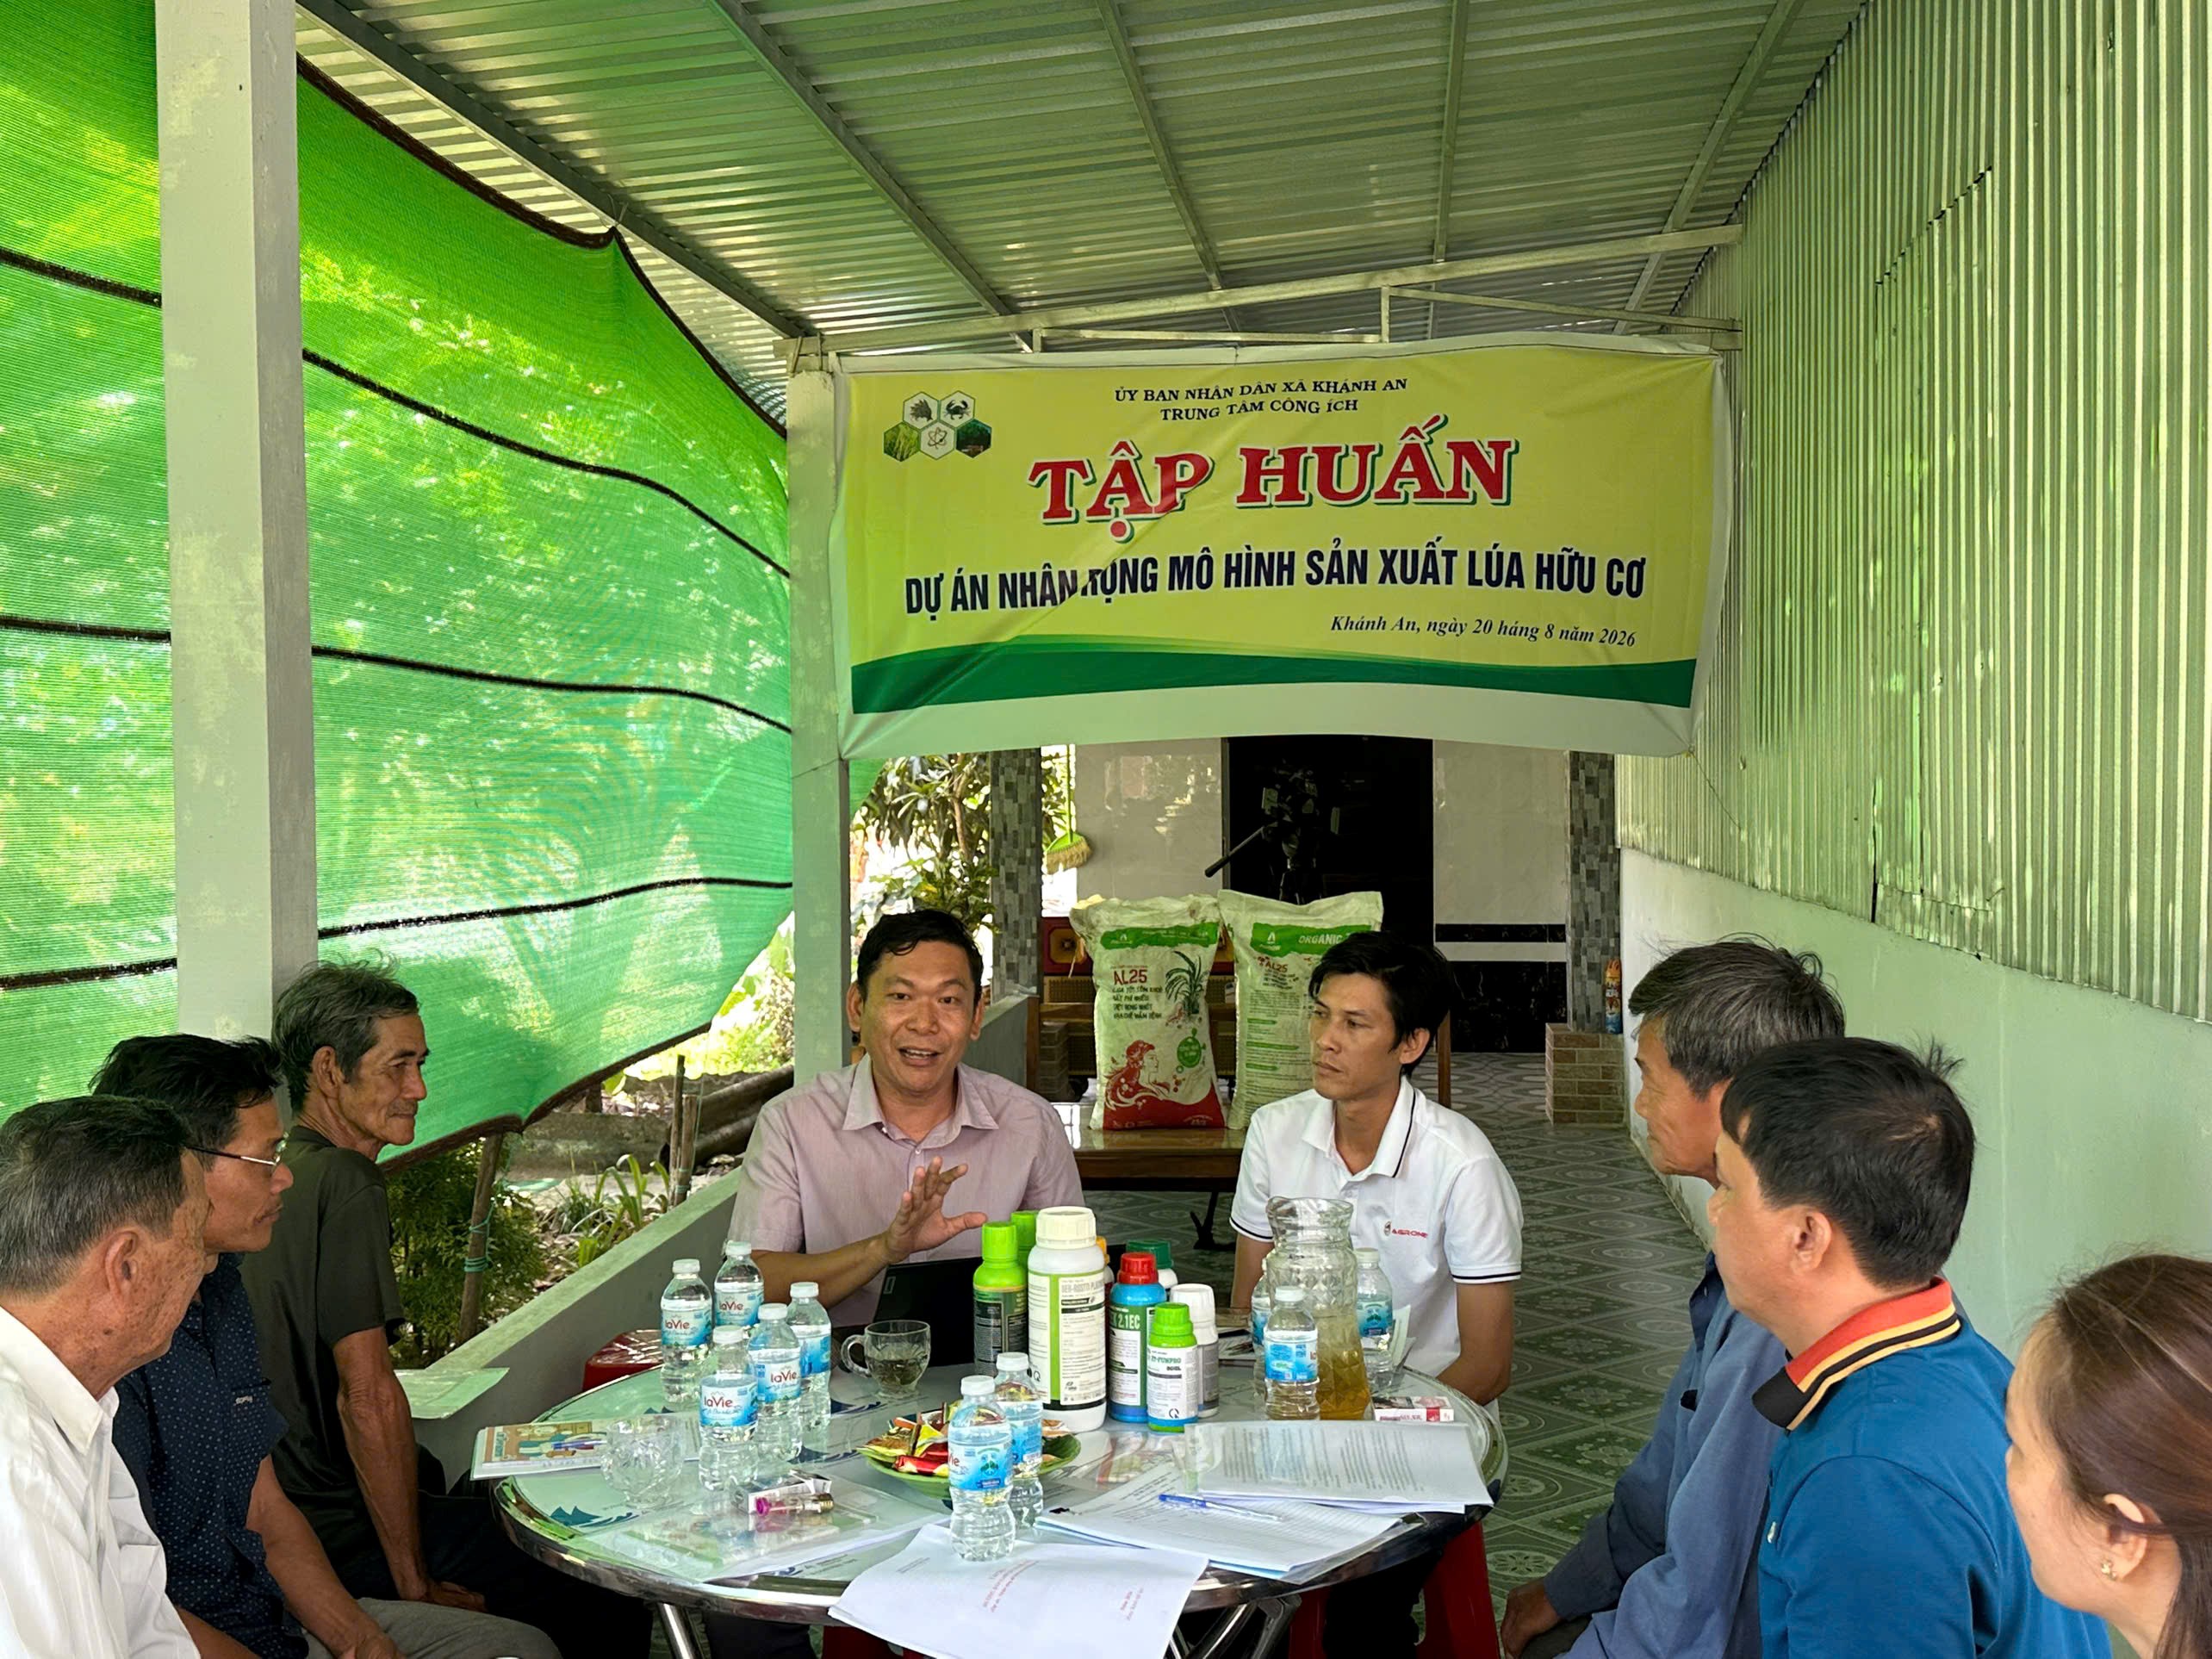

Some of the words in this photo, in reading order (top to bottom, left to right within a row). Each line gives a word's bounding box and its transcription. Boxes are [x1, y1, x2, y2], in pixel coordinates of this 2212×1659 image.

[1115, 386, 1138, 401] ỦY
[1144, 389, 1179, 401] BAN
[1185, 385, 1234, 400] NHÂN
[1240, 382, 1277, 395] DÂN
[1282, 379, 1307, 393] XÃ
[1313, 379, 1376, 394] KHÁNH
[1382, 379, 1407, 391] AN
[1160, 407, 1220, 420] TRUNG
[1227, 401, 1264, 415] TÂM
[1270, 398, 1320, 413] CÔNG
[1028, 439, 1215, 542] TẬP
[1236, 414, 1519, 506] HUẤN
[905, 572, 945, 621] DỰ
[950, 568, 989, 612] ÁN
[998, 562, 1078, 609] NHÂN
[1168, 546, 1214, 591] MÔ
[1224, 544, 1296, 587] HÌNH
[1305, 537, 1369, 586] SẢN
[1378, 536, 1458, 585] XUẤT
[1468, 543, 1525, 588] LÚA
[1536, 547, 1596, 593] HỮU
[1606, 557, 1646, 599] CƠ
[1331, 615, 1387, 631] Khánh
[1391, 616, 1420, 634] An,
[1426, 617, 1468, 637] ngày
[1472, 618, 1494, 635] 20
[1544, 623, 1555, 639] 8
[1559, 626, 1594, 643] năm
[1599, 628, 1637, 647] 2026
[1298, 934, 1343, 945] ORGANIC
[1264, 960, 1289, 973] AL25
[1114, 969, 1148, 985] AL25
[770, 1370, 797, 1383] laVie
[704, 1395, 733, 1408] laVie
